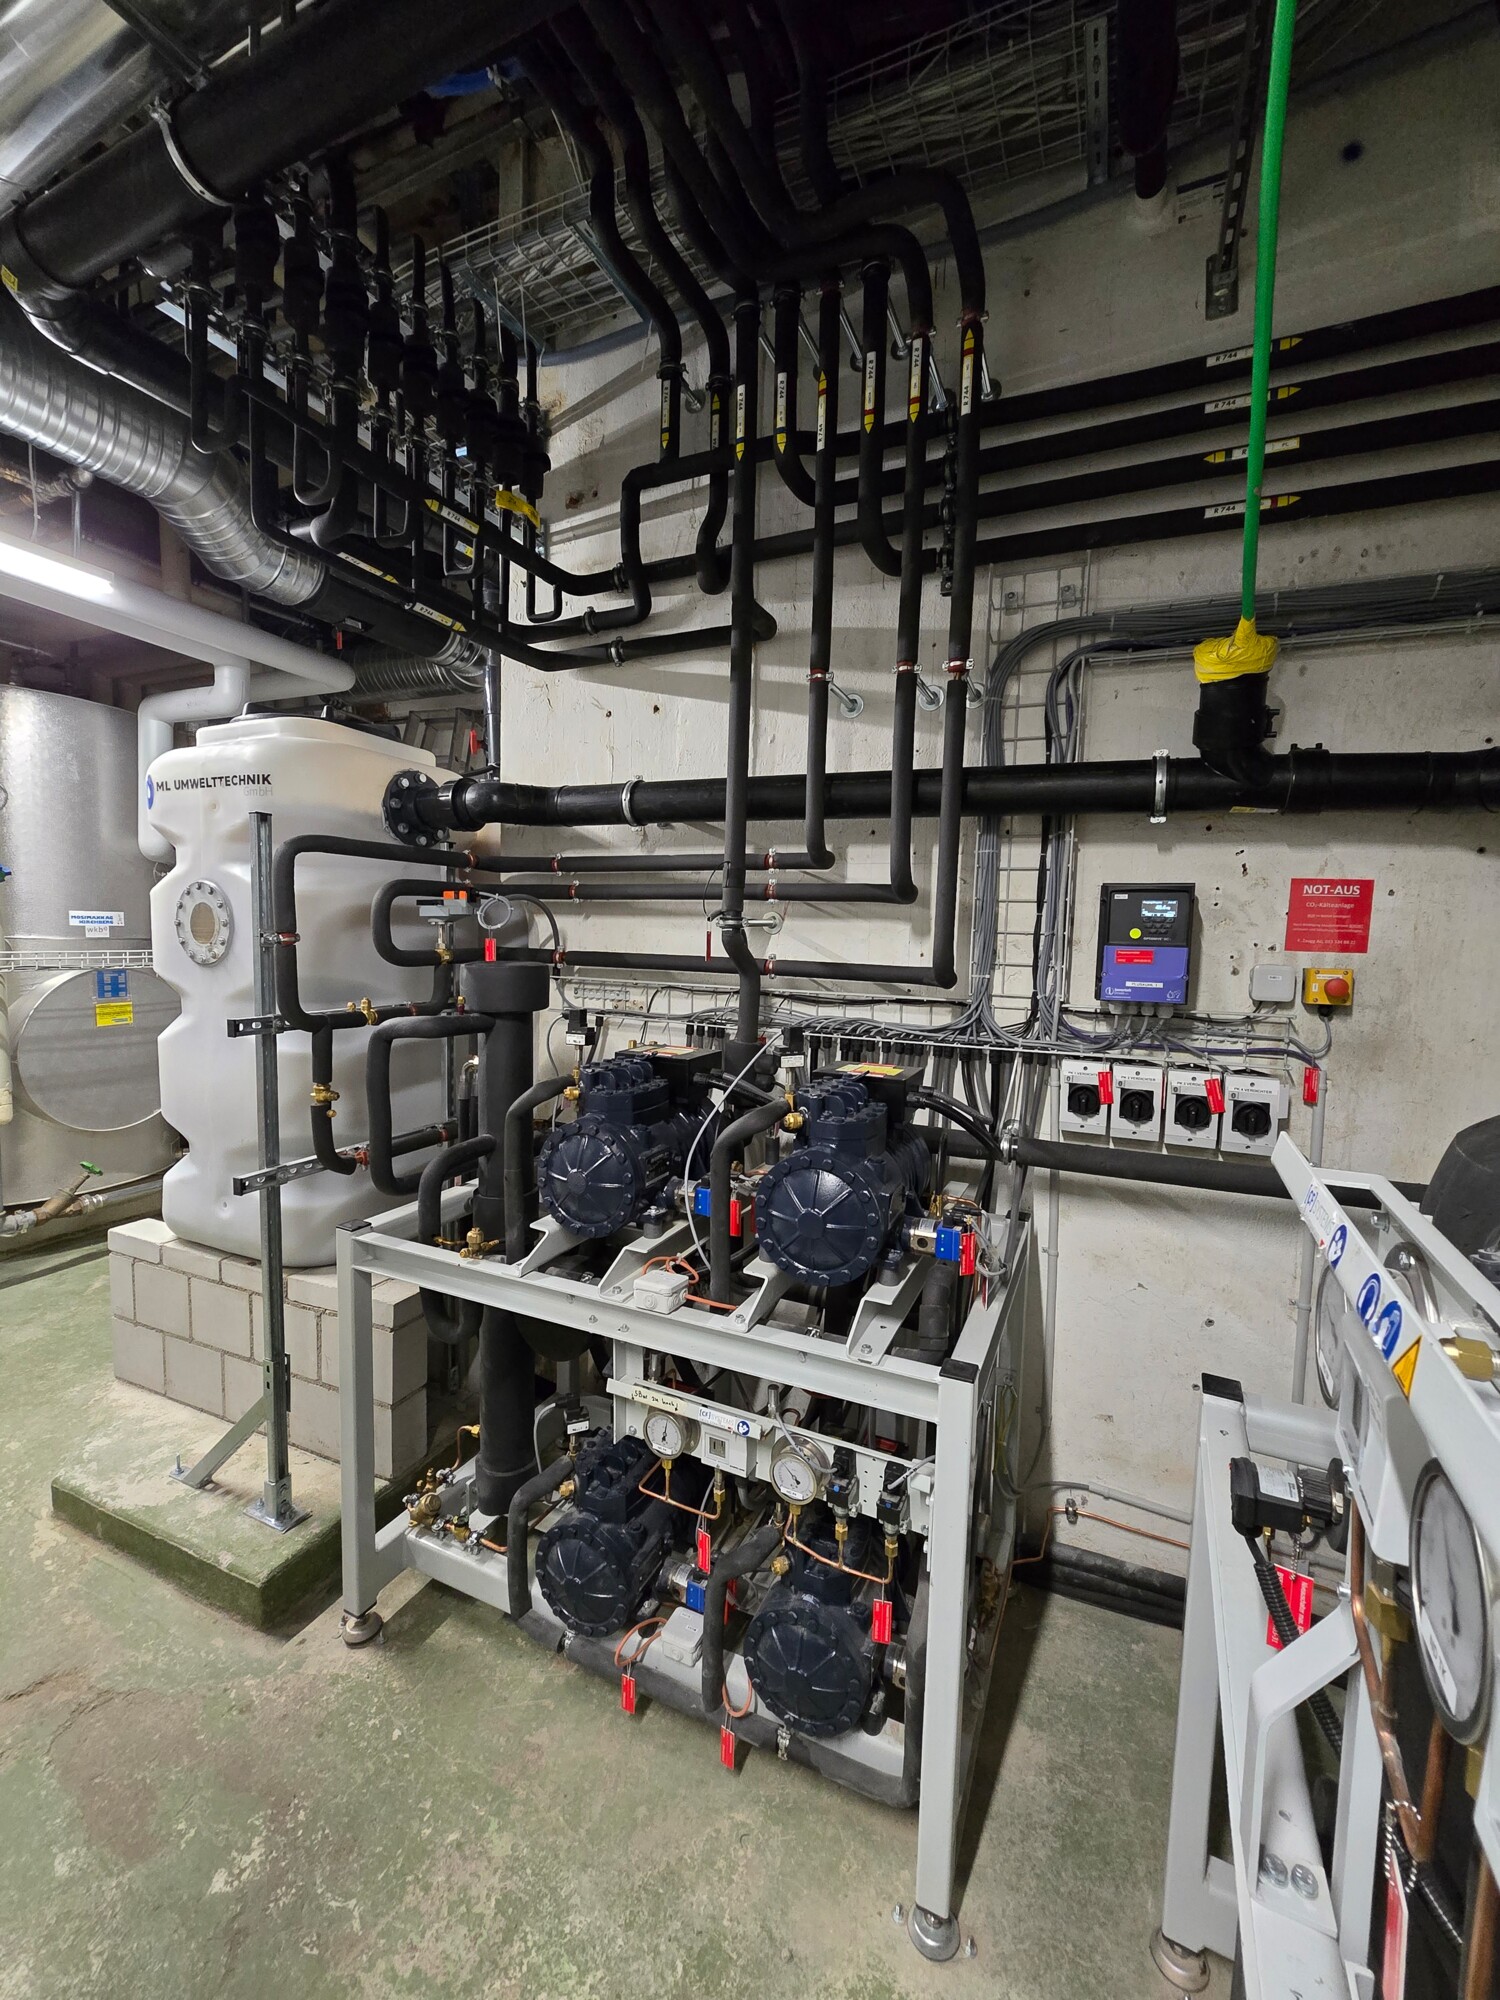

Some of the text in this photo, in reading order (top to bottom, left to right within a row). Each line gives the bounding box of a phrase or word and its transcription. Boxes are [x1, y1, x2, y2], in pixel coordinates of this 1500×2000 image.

[1222, 352, 1238, 361] 744
[1220, 399, 1237, 408] 744
[1220, 504, 1236, 513] 744
[451, 512, 461, 522] 744
[424, 608, 434, 617] 744
[156, 773, 272, 792] ML UMWELTTECHNIK
[243, 786, 273, 797] GmbH
[1303, 884, 1360, 895] NOT-AUS
